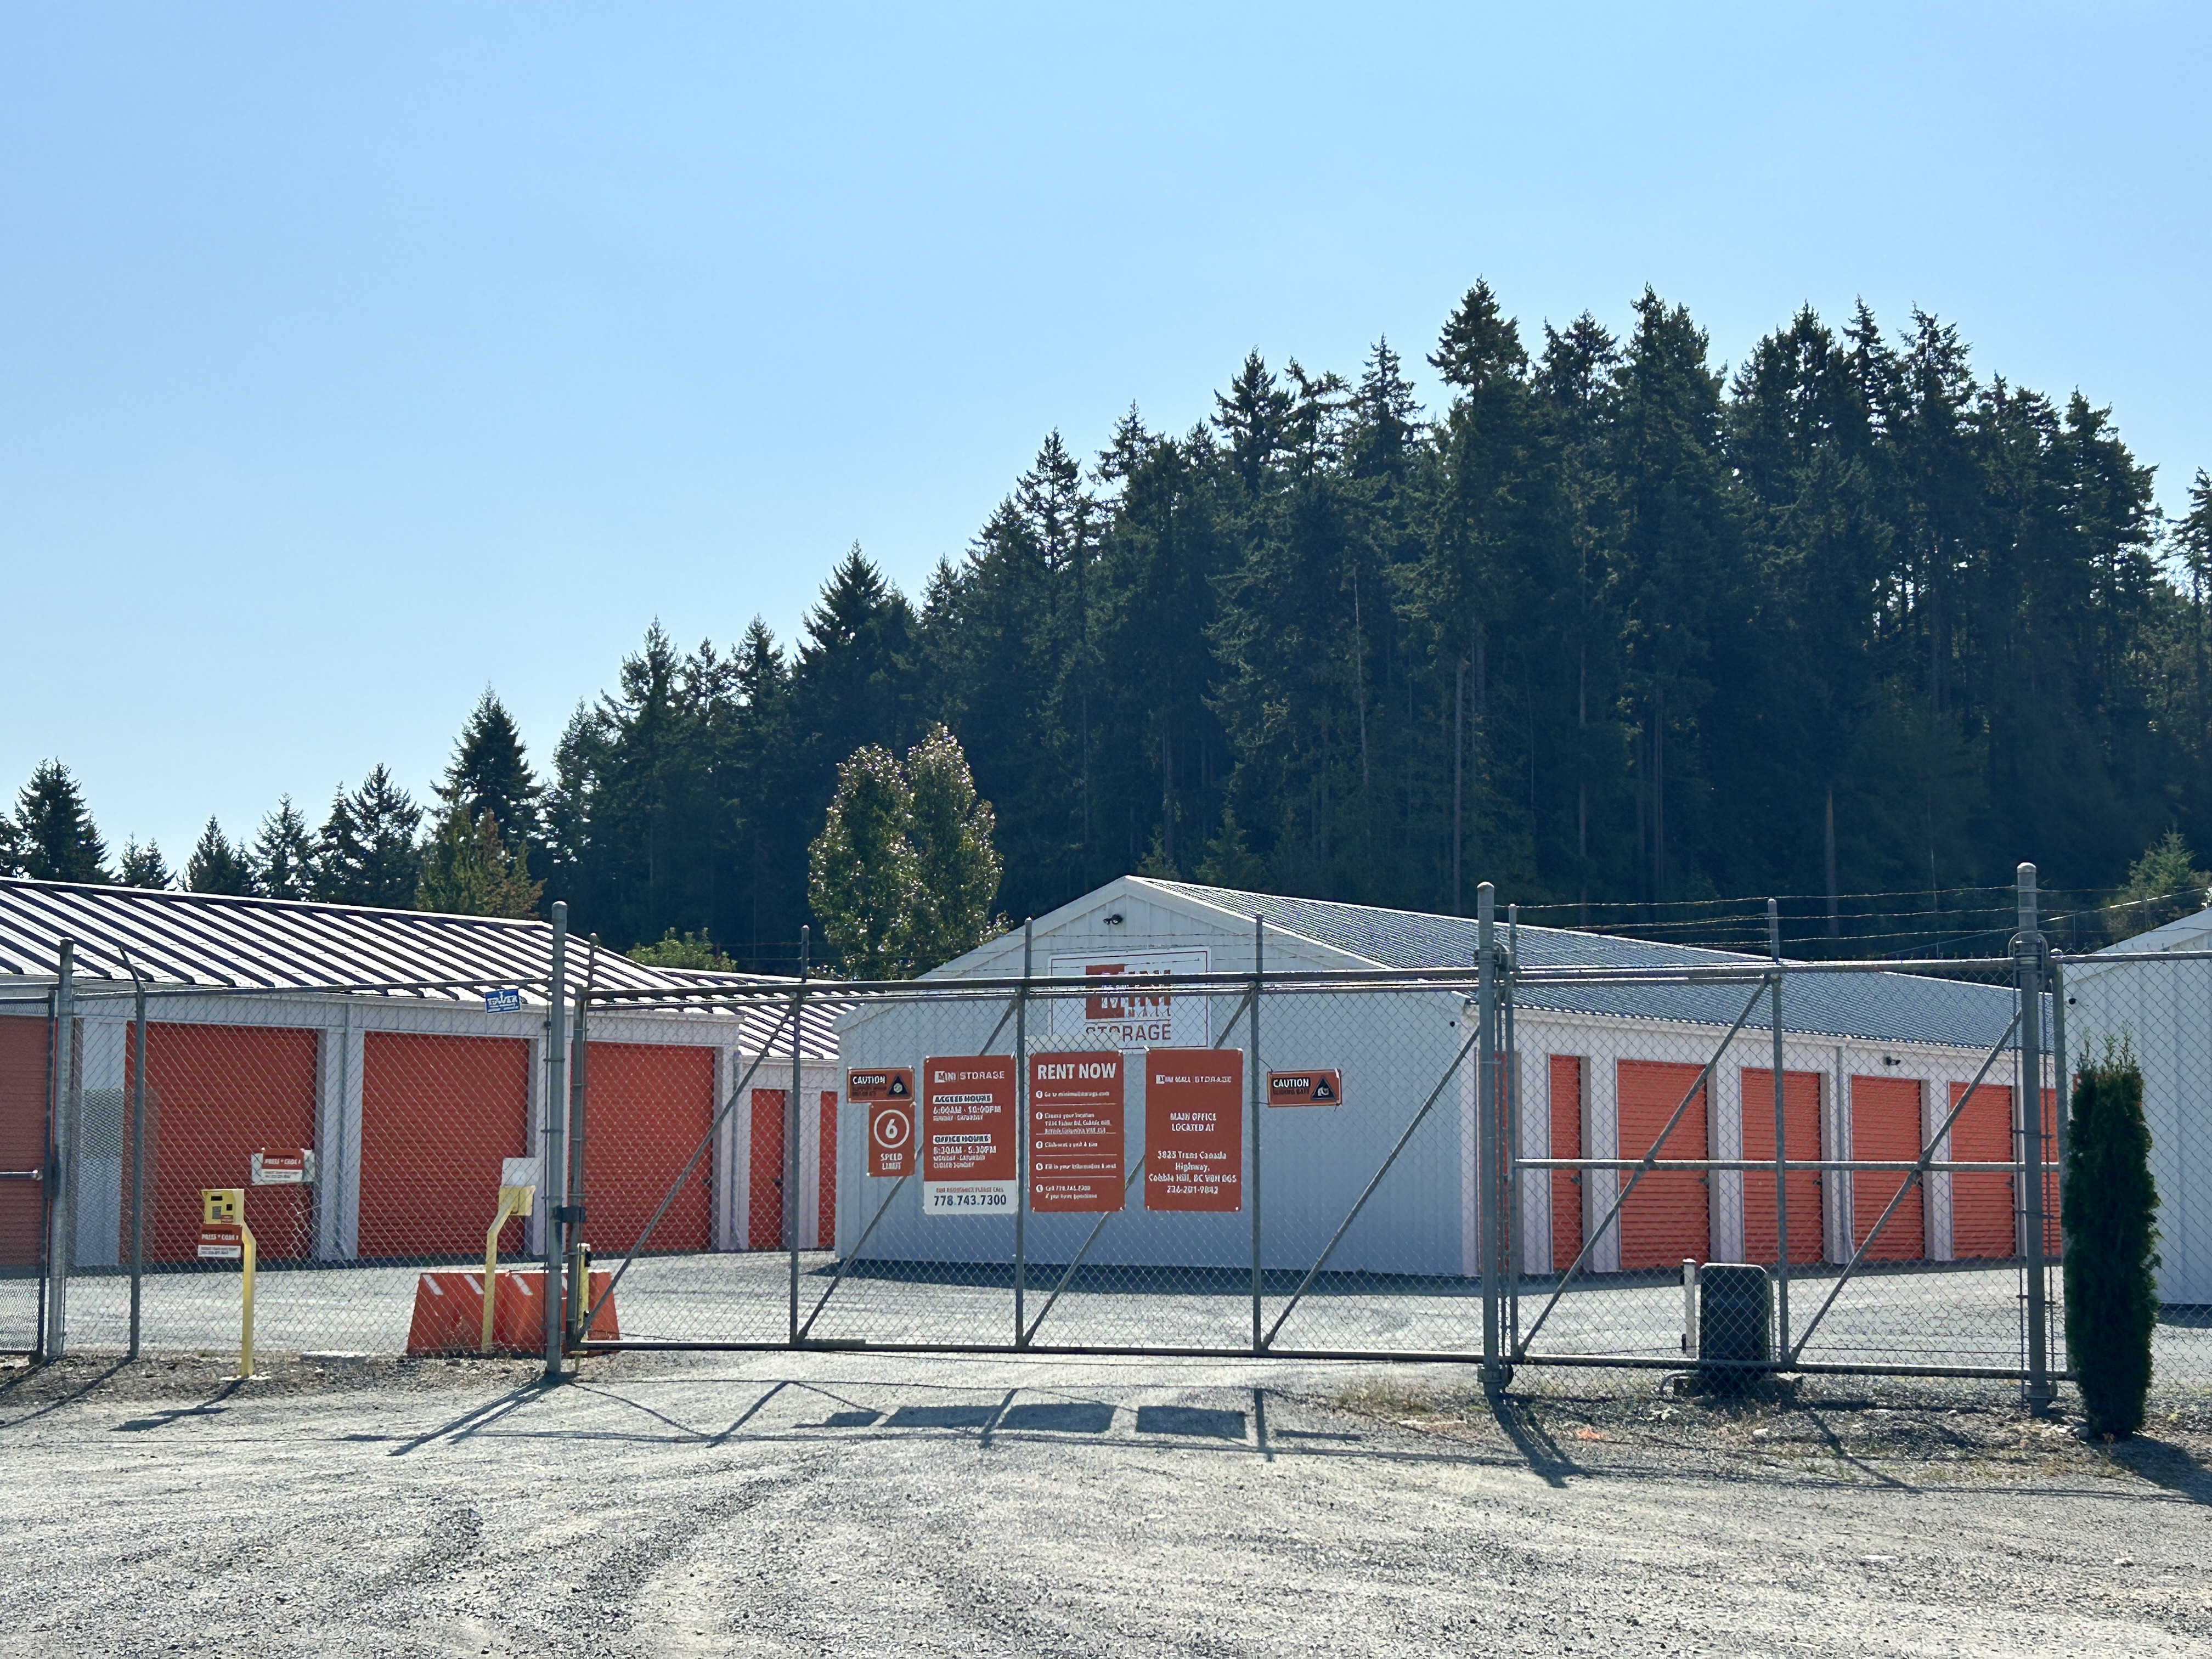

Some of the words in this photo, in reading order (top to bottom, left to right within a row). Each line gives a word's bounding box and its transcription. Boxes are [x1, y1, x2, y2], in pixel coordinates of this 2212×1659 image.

[960, 1071, 1005, 1080] STORAGE
[1037, 1063, 1075, 1080] RENT
[1079, 1062, 1116, 1079] NOW
[853, 1075, 885, 1085] CAUTION
[1273, 1078, 1309, 1088] CAUTION
[1170, 1113, 1190, 1121] MAIN
[1192, 1113, 1216, 1121] OFFICE
[885, 1119, 898, 1139] 6
[881, 1153, 903, 1161] SPEED
[882, 1161, 901, 1170] LIMIT
[934, 1194, 1007, 1206] 778.743.7300
